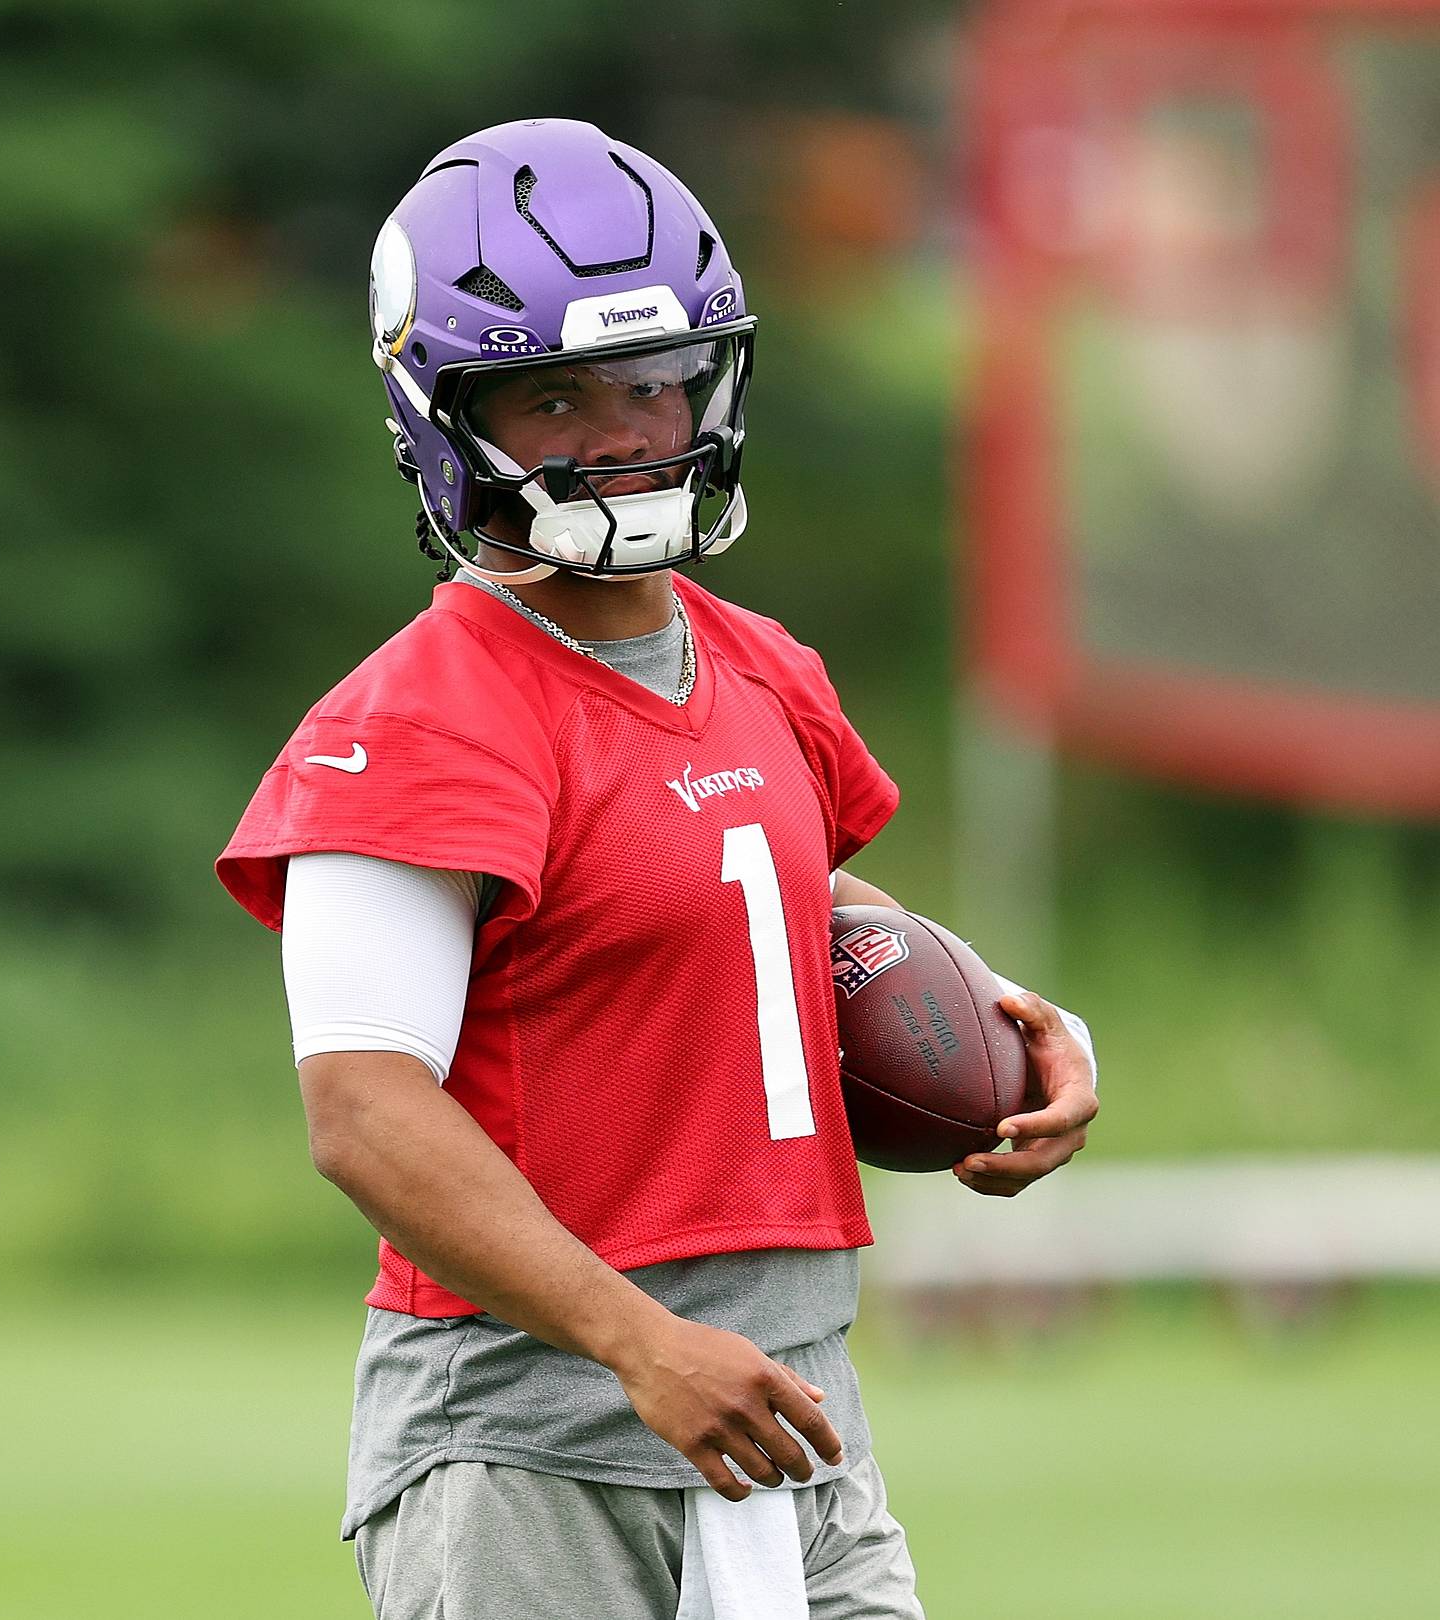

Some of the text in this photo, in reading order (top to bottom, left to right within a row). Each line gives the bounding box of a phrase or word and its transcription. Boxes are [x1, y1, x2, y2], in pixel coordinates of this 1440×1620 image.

[706, 303, 736, 324] OAKLEY
[481, 343, 538, 353] OAKLEY
[845, 927, 898, 971] NFL
[720, 822, 817, 1141] 1
[921, 988, 961, 1057] Wilson
